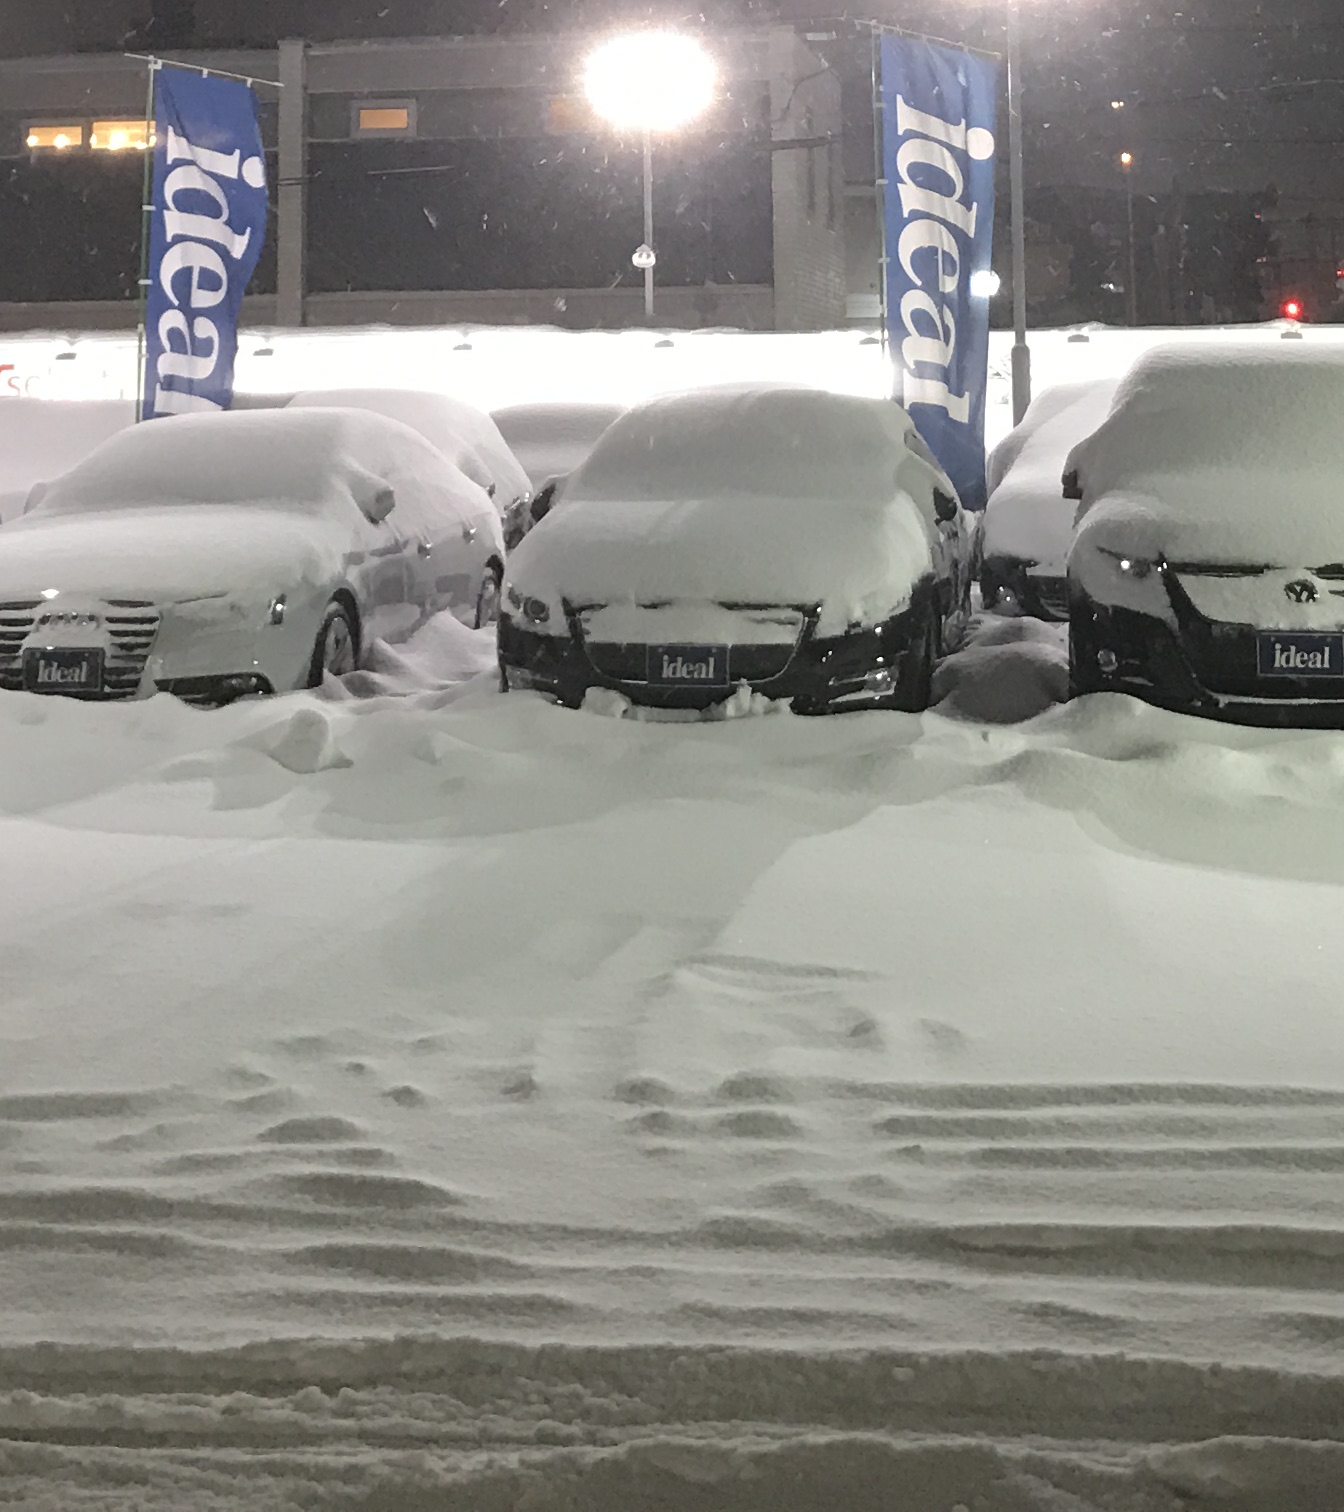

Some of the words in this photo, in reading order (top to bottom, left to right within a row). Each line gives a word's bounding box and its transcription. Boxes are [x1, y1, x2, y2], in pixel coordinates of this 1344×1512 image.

[154, 124, 266, 414] ideal
[895, 93, 996, 424] ideal
[662, 654, 715, 679] ideal
[1274, 643, 1330, 669] ideal
